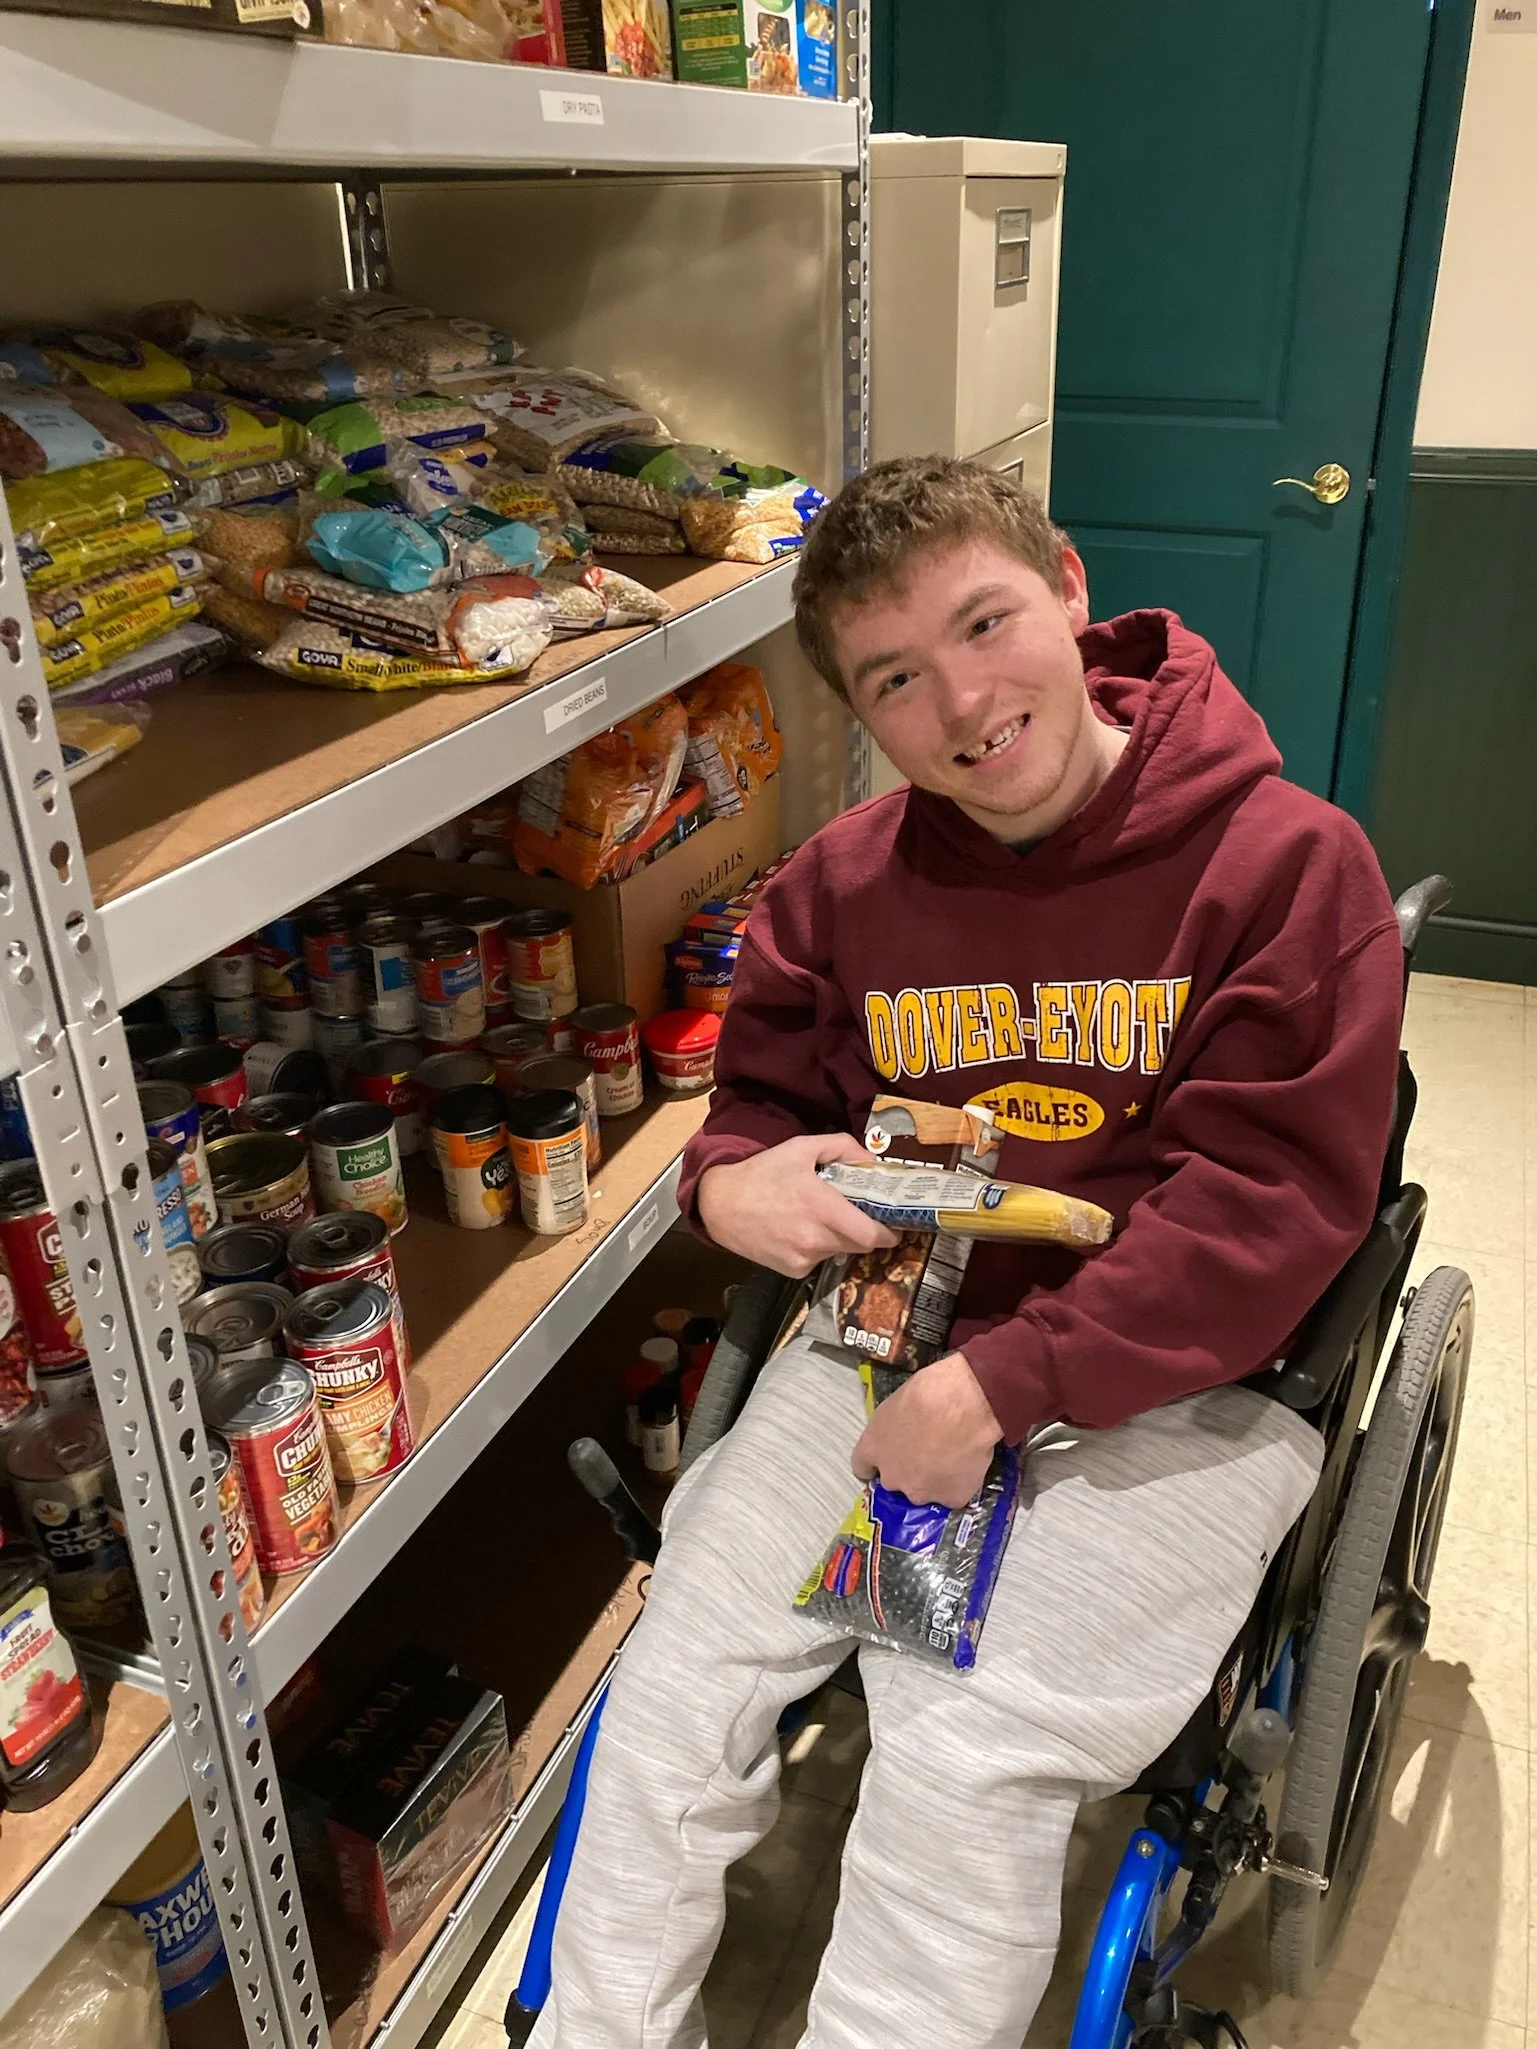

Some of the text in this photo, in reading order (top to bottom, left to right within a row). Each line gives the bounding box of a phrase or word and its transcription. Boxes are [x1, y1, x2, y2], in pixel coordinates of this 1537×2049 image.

[1494, 9, 1522, 21] Men
[302, 653, 339, 665] GOYA
[563, 684, 605, 716] DRIED BEANS
[680, 847, 745, 910] STUFFING
[981, 1097, 1090, 1127] EAGLES
[343, 1155, 387, 1174] Choice
[348, 1146, 385, 1163] Healthy
[352, 1175, 387, 1190] Chicken
[260, 1196, 300, 1222] German
[284, 1202, 305, 1222] Soup
[353, 1391, 392, 1420] CHICKEN
[282, 1489, 307, 1508] OLD
[160, 1883, 214, 1949] HOU
